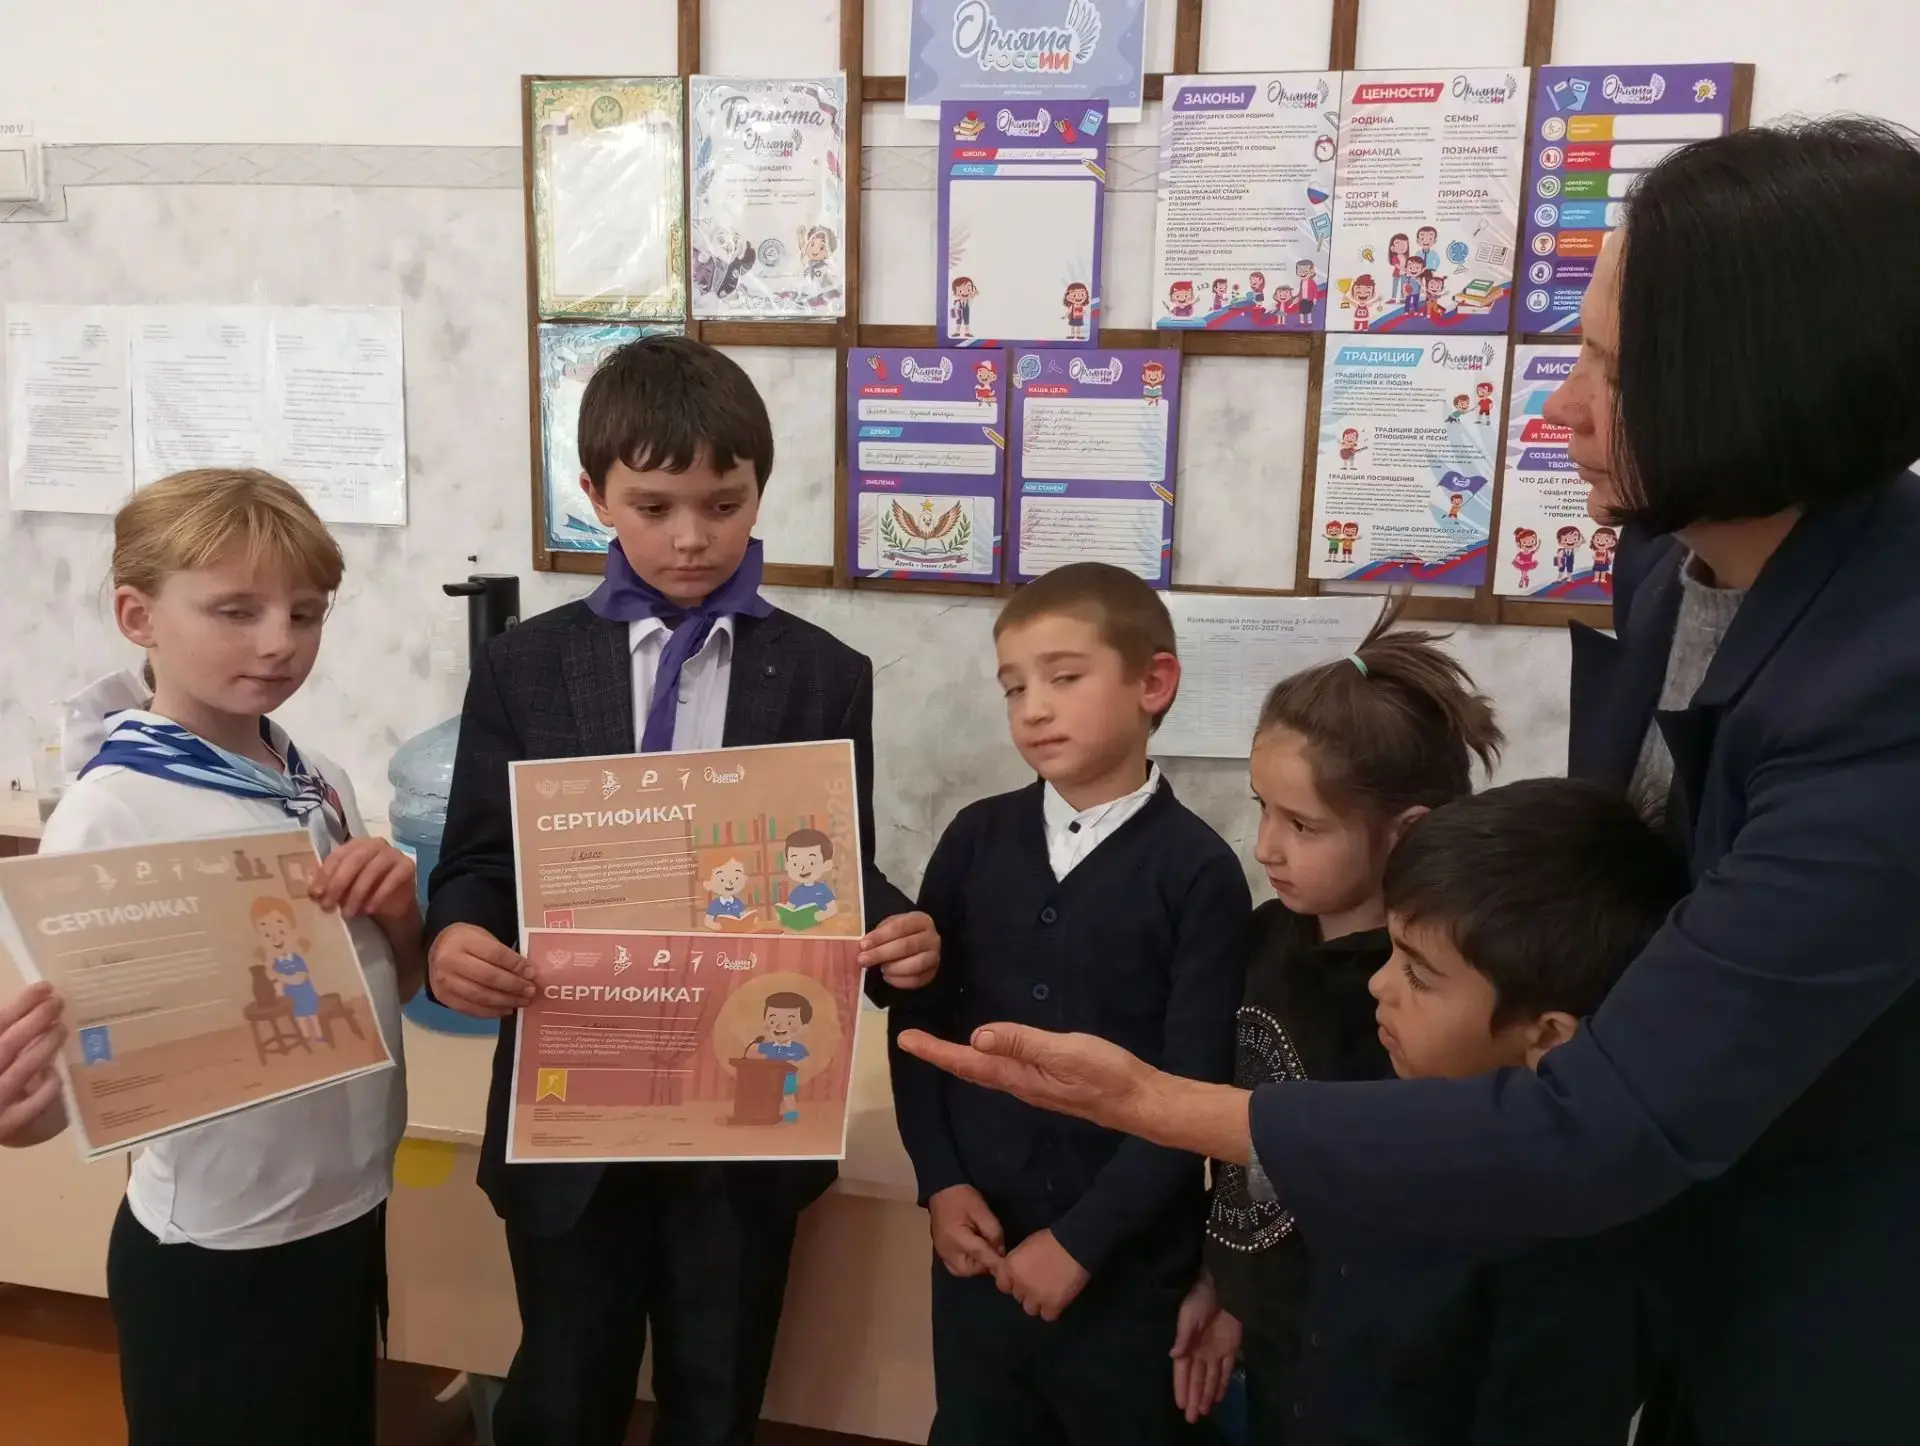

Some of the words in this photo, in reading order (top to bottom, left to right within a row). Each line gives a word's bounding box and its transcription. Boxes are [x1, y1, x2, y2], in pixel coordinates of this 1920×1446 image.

[955, 1, 1073, 58] Орлята
[1452, 75, 1505, 99] Орлята
[1183, 92, 1245, 105] ЗАКОНЫ
[1267, 80, 1319, 107] Орлята
[1362, 88, 1435, 101] ЦЕННОСТИ
[721, 96, 825, 135] Грамота
[1351, 116, 1395, 125] РОДИНА
[1444, 114, 1479, 122] СЕМЬЯ
[16, 124, 24, 134] V
[1348, 148, 1402, 157] КОМАНДА
[1442, 146, 1499, 155] ПОЗНАНИЕ
[1345, 191, 1380, 200] СПОРТ
[1381, 191, 1390, 199] И
[1438, 190, 1489, 199] ПРИРОДА
[1344, 200, 1399, 210] ЗДОРОВЬЕ
[1344, 350, 1416, 364] ТРАДИЦИИ
[1431, 341, 1484, 367] Орлята
[1374, 372, 1407, 380] ДОБРОГО
[1425, 434, 1449, 442] ПЕСНЕ
[1531, 432, 1538, 440] И
[1540, 432, 1573, 440] ТАЛАНТ
[1528, 452, 1569, 460] СОЗДАНИ
[1536, 476, 1560, 484] ДАЁТ
[536, 804, 697, 832] СЕРТИФИКАТ
[38, 896, 200, 935] СЕРТИФИКАТ
[544, 985, 704, 1003] СЕРТИФИКАТ
